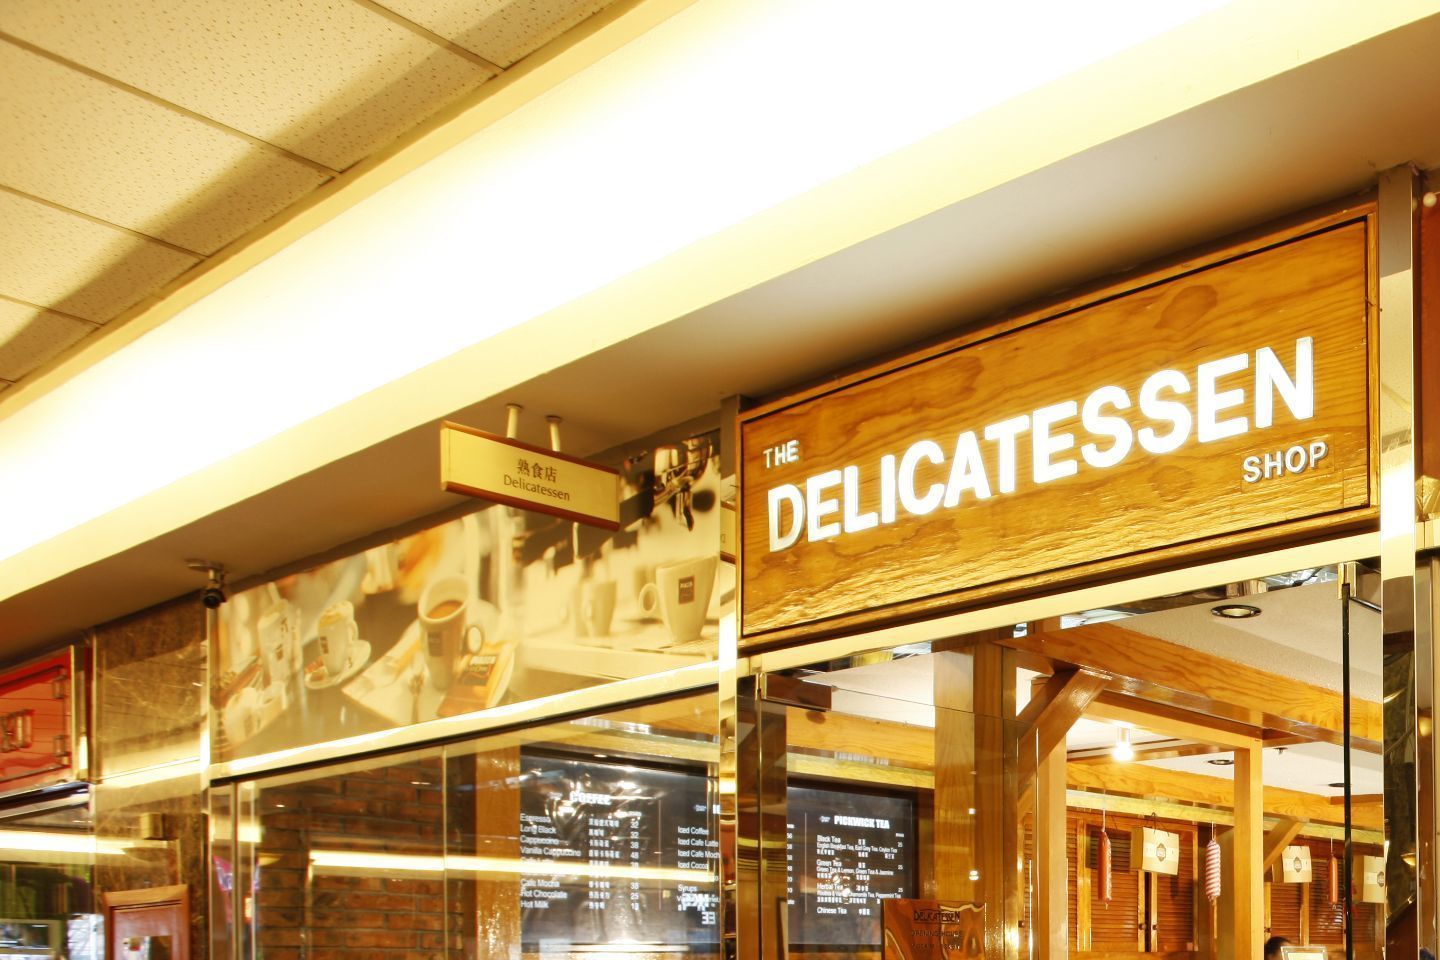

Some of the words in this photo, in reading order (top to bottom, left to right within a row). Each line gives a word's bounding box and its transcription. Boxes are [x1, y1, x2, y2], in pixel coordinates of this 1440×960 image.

[763, 439, 799, 470] THE
[768, 336, 1315, 554] DELICATESSEN
[517, 458, 558, 483] 熟食店
[1242, 440, 1328, 484] SHOP
[504, 474, 570, 501] Delicatessen
[678, 826, 690, 834] Iced
[691, 827, 709, 835] Coffee
[834, 815, 875, 828] PICKWICK
[875, 819, 890, 829] TEA
[678, 838, 690, 846] Iced
[691, 838, 704, 846] Cafe
[678, 850, 690, 858] Iced
[691, 850, 704, 859] Cafe
[705, 851, 720, 859] Moch
[678, 861, 690, 869] Iced
